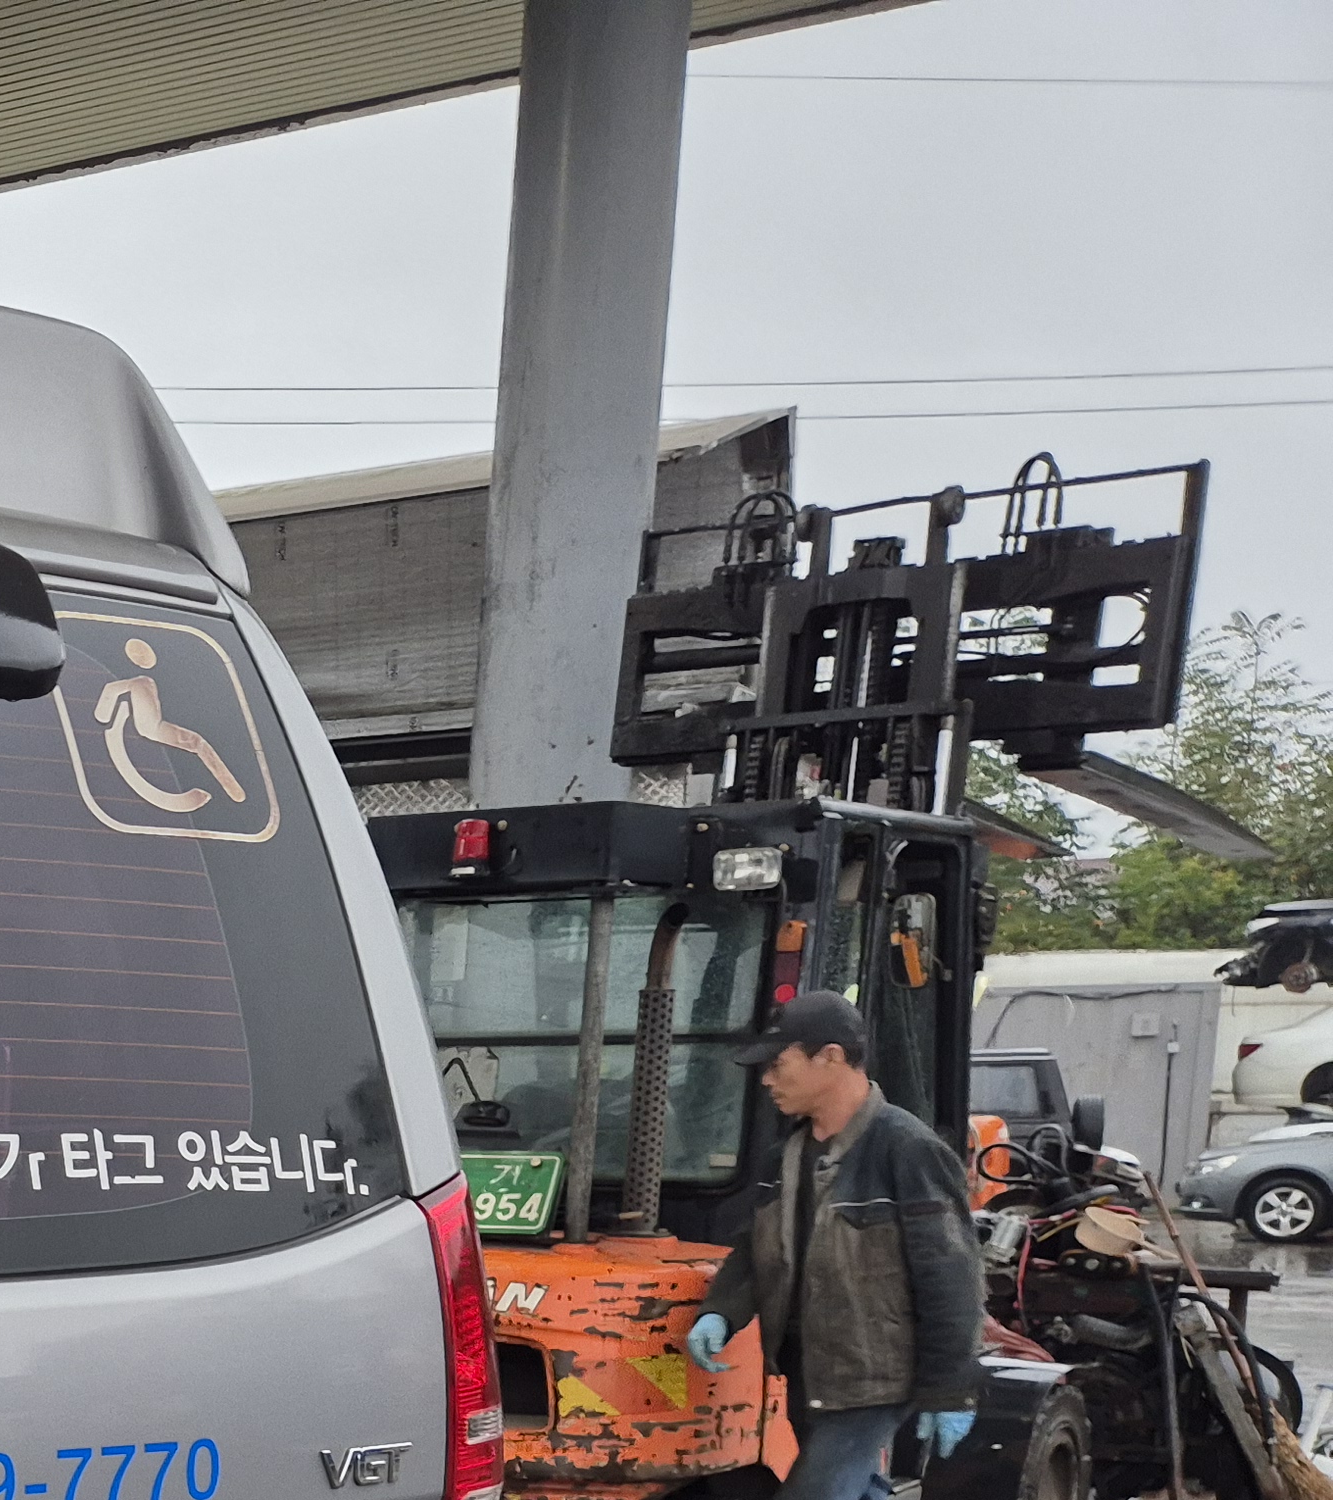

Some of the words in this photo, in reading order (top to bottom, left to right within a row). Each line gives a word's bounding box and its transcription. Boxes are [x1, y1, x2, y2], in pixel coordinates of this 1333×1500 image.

[60, 1128, 164, 1190] 타고
[177, 1129, 370, 1196] 있습니다.
[319, 1441, 413, 1490] VGT
